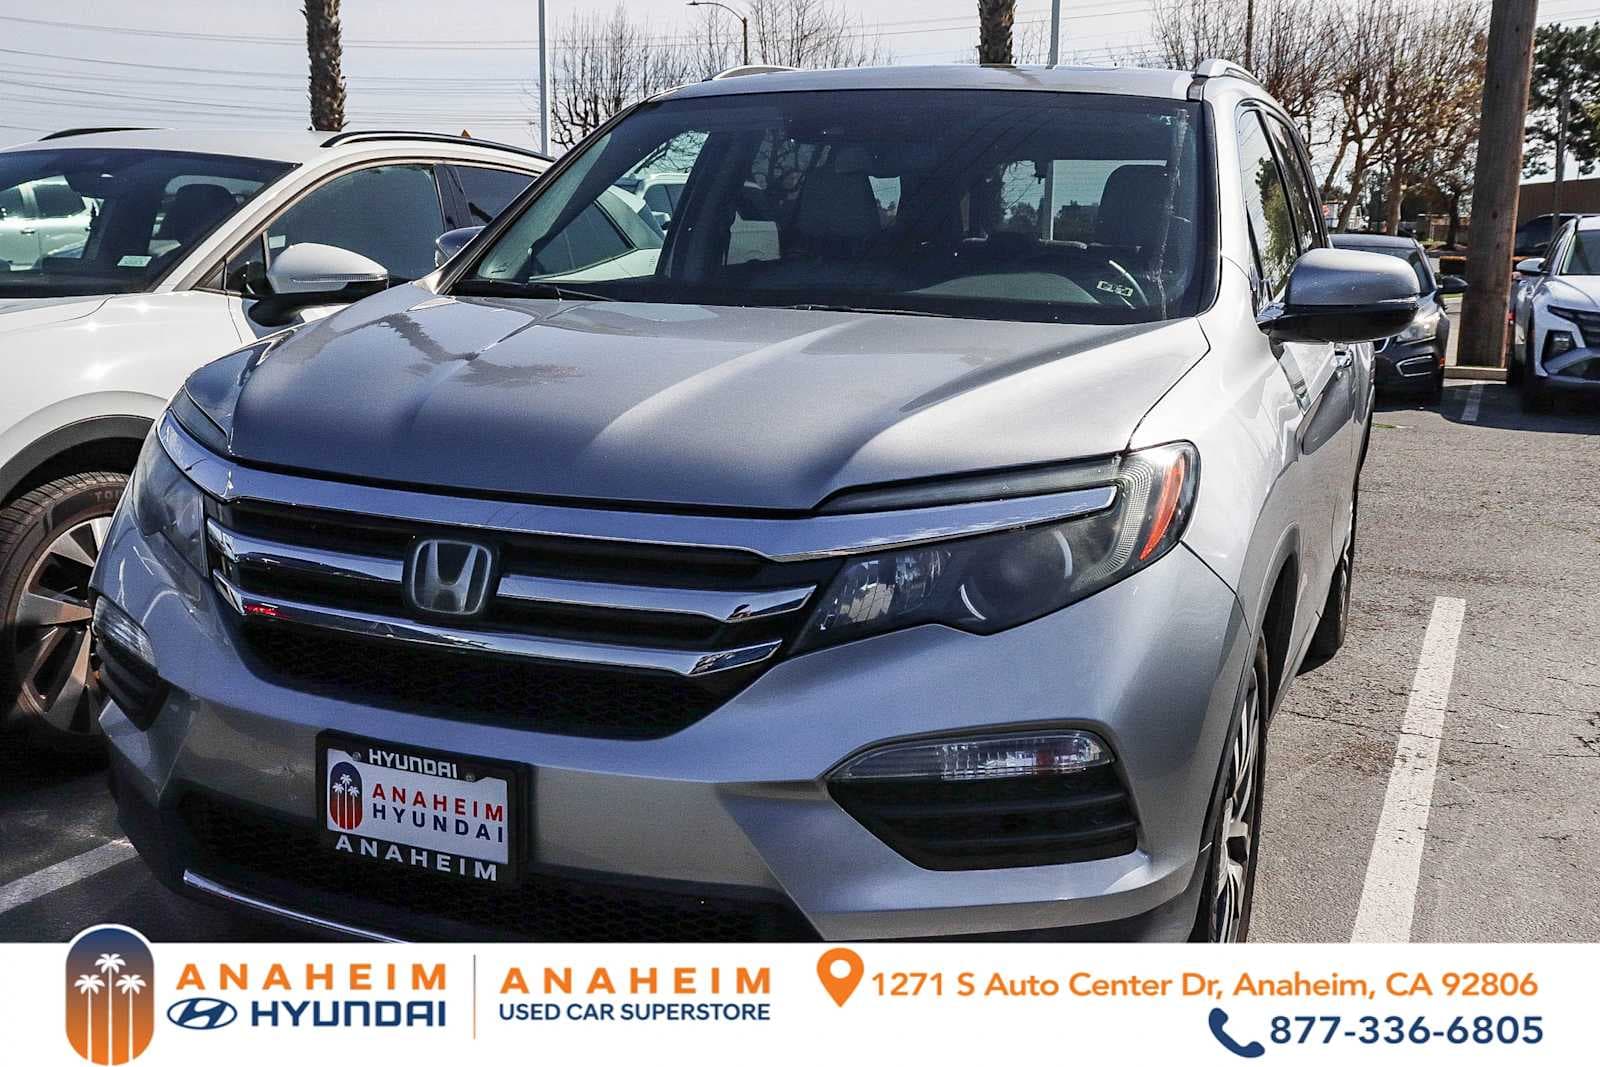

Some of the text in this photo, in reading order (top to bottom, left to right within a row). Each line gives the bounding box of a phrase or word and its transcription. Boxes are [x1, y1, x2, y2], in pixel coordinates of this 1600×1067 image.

[369, 748, 458, 779] HYUNDAI
[372, 783, 503, 822] ANAHEIM
[372, 803, 503, 843] HYUNDAI
[335, 834, 497, 881] ANAHEIM
